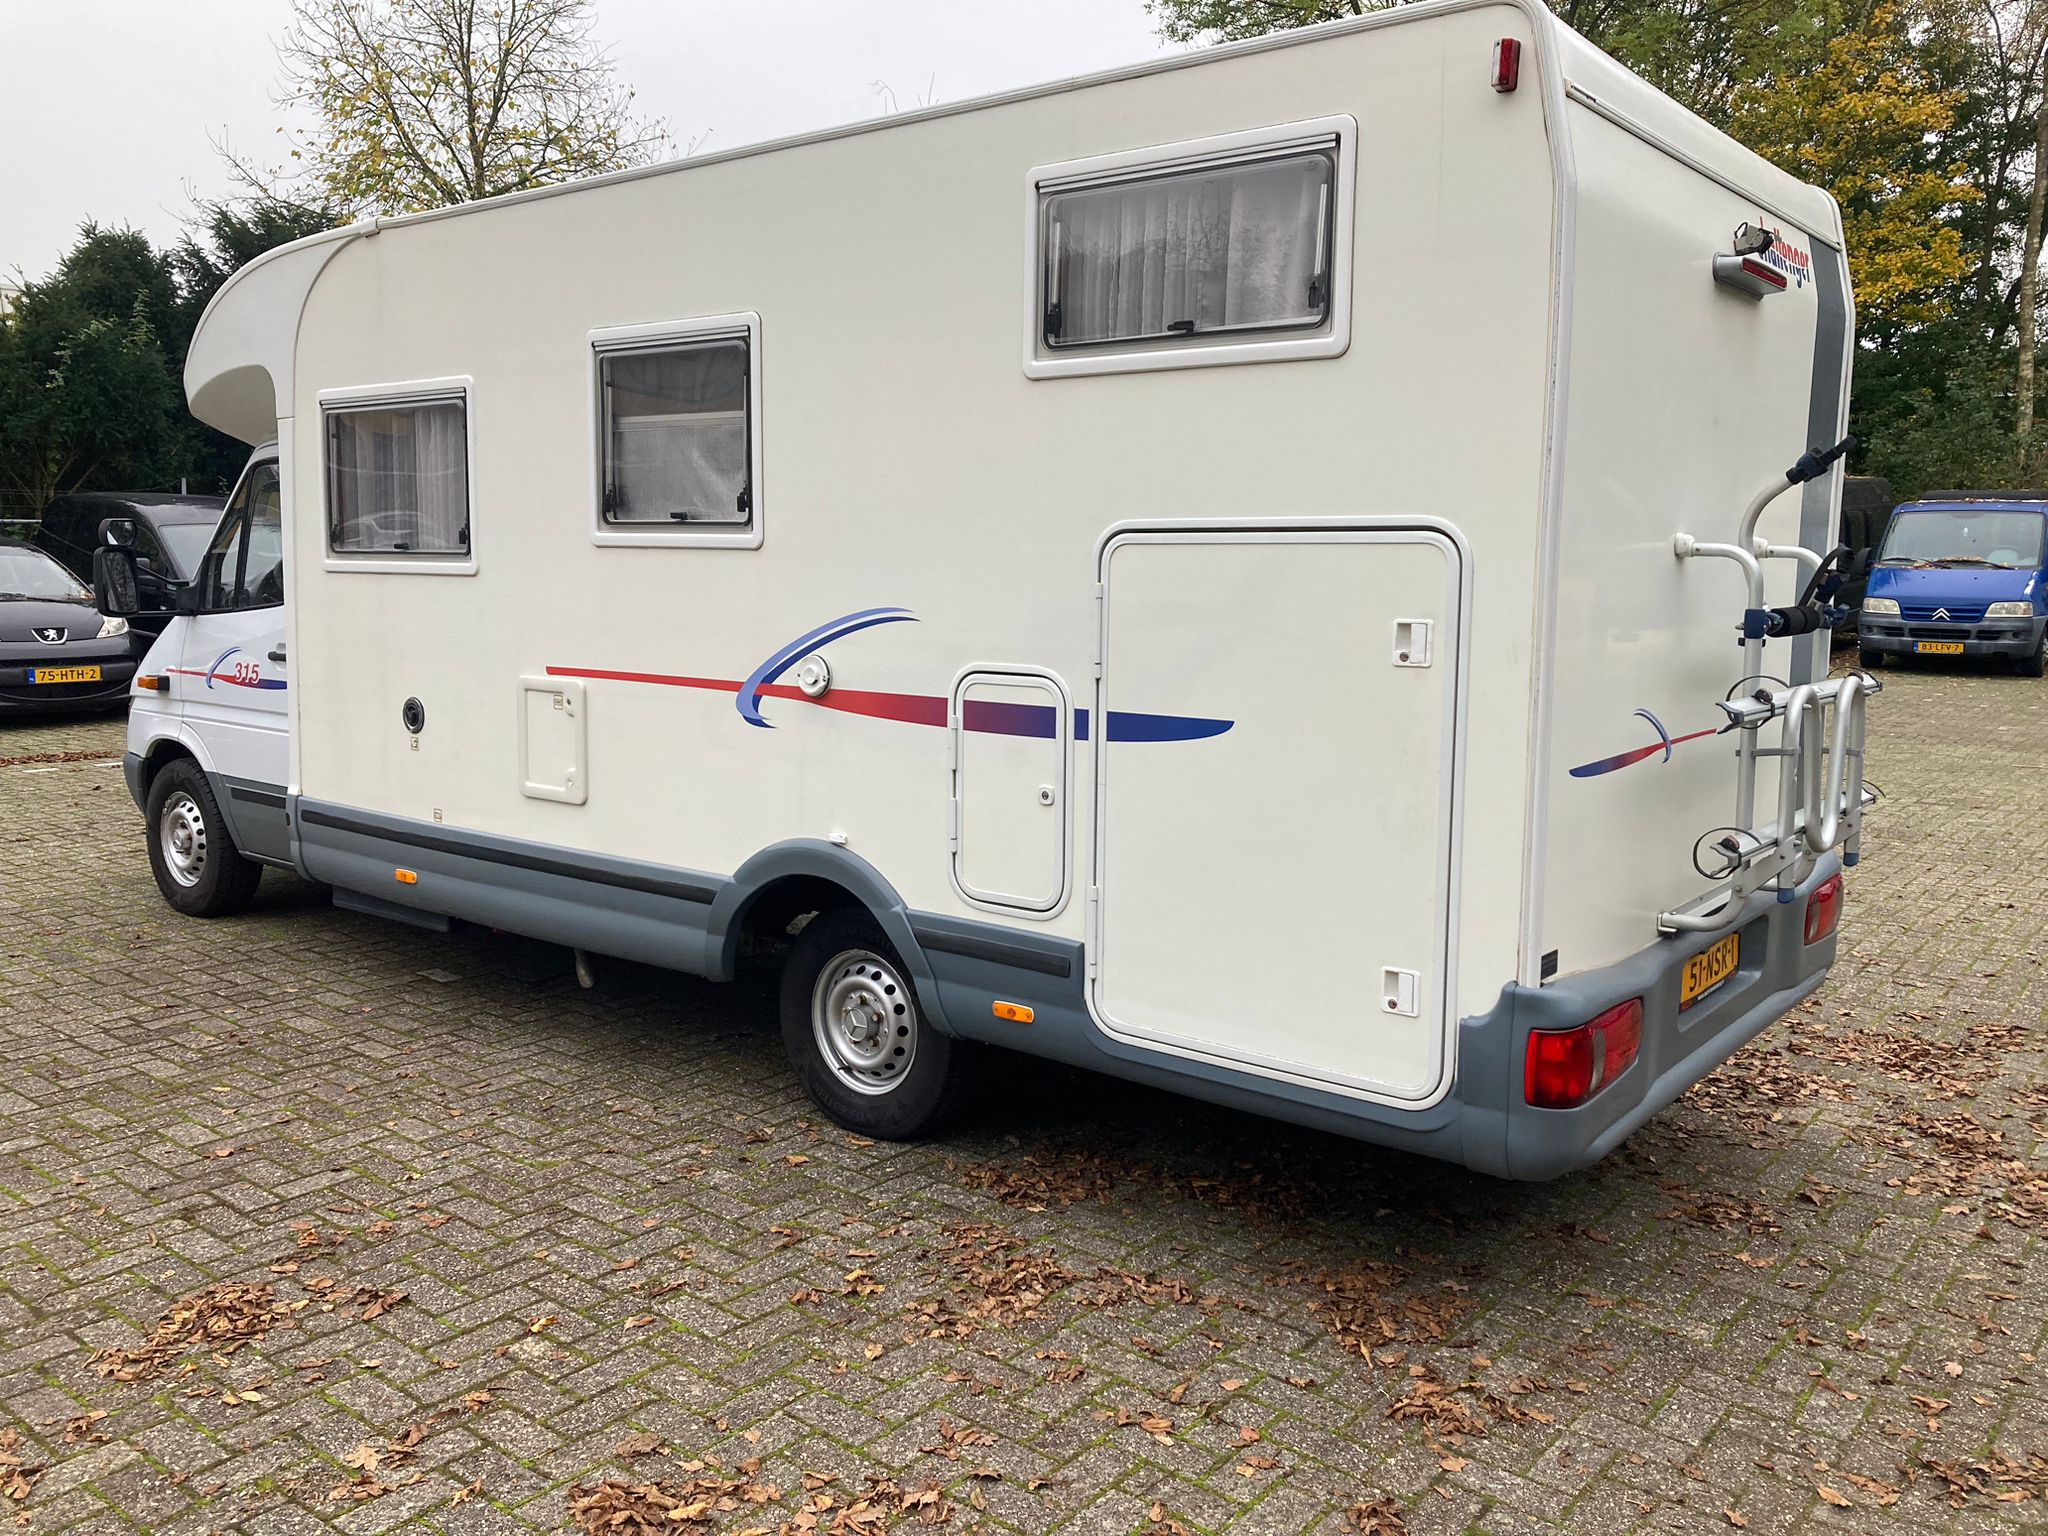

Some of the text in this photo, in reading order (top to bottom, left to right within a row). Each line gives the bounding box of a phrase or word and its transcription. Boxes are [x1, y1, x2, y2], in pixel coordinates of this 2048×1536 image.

[39, 669, 97, 681] 75-HTH-2
[234, 662, 259, 683] 315
[1689, 936, 1735, 992] 51-NSR-1
